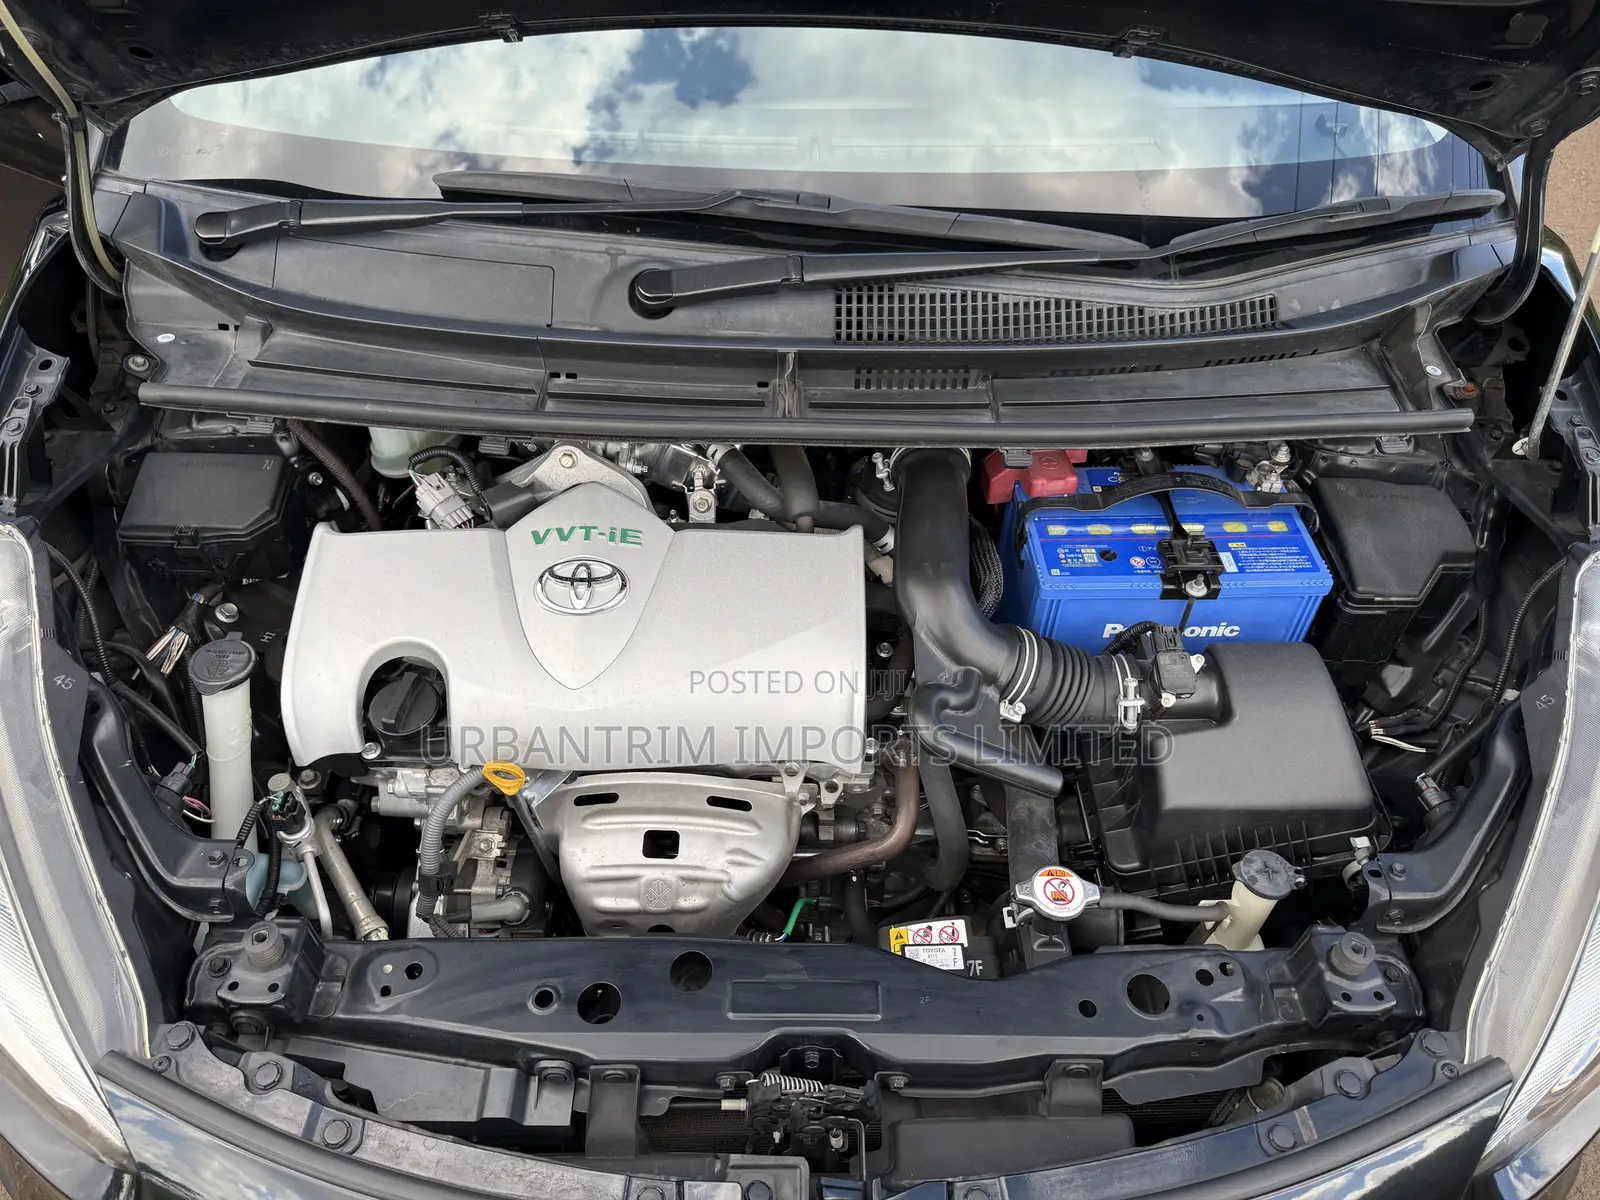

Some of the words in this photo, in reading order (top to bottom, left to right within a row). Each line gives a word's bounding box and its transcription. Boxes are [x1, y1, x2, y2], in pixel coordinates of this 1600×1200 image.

[530, 525, 643, 547] VVT-iE
[1102, 622, 1241, 639] Ponic
[53, 674, 76, 690] 45
[1535, 694, 1556, 710] 45
[966, 959, 984, 977] 7F
